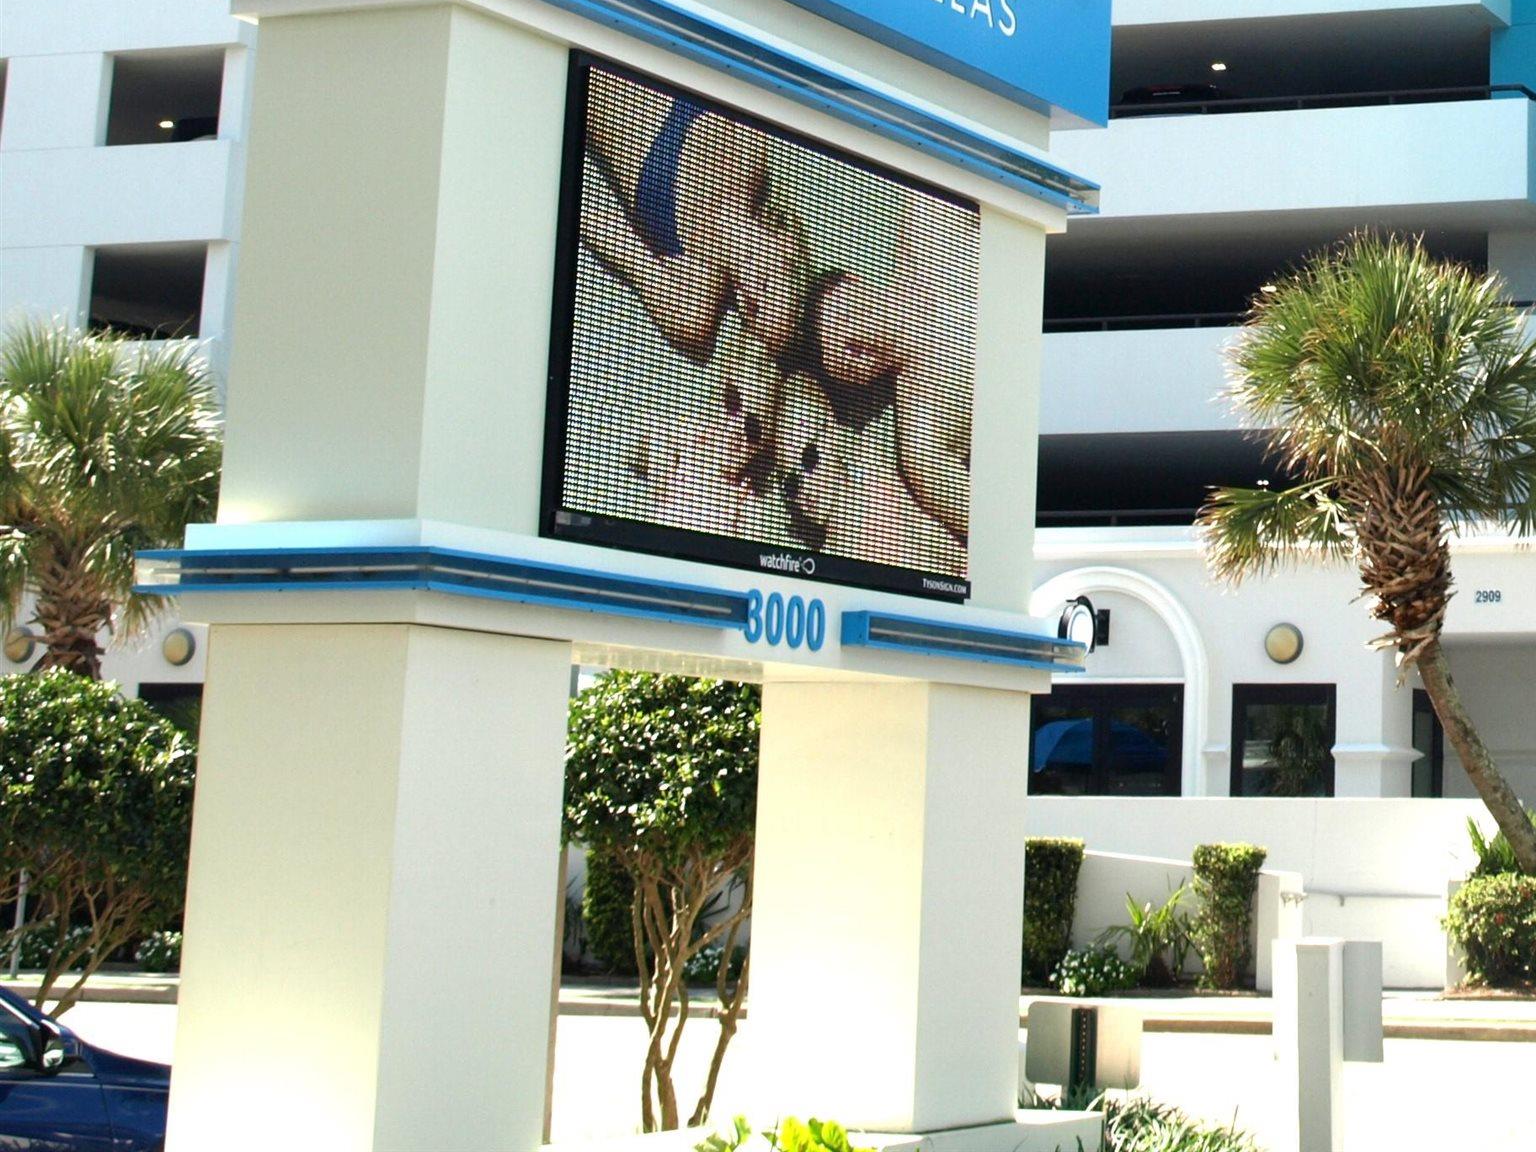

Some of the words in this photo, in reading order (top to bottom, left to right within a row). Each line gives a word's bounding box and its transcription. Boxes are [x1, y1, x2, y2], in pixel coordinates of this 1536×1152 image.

[760, 552, 801, 573] watchfire
[1475, 590, 1502, 603] 2909
[744, 588, 826, 652] 3000
